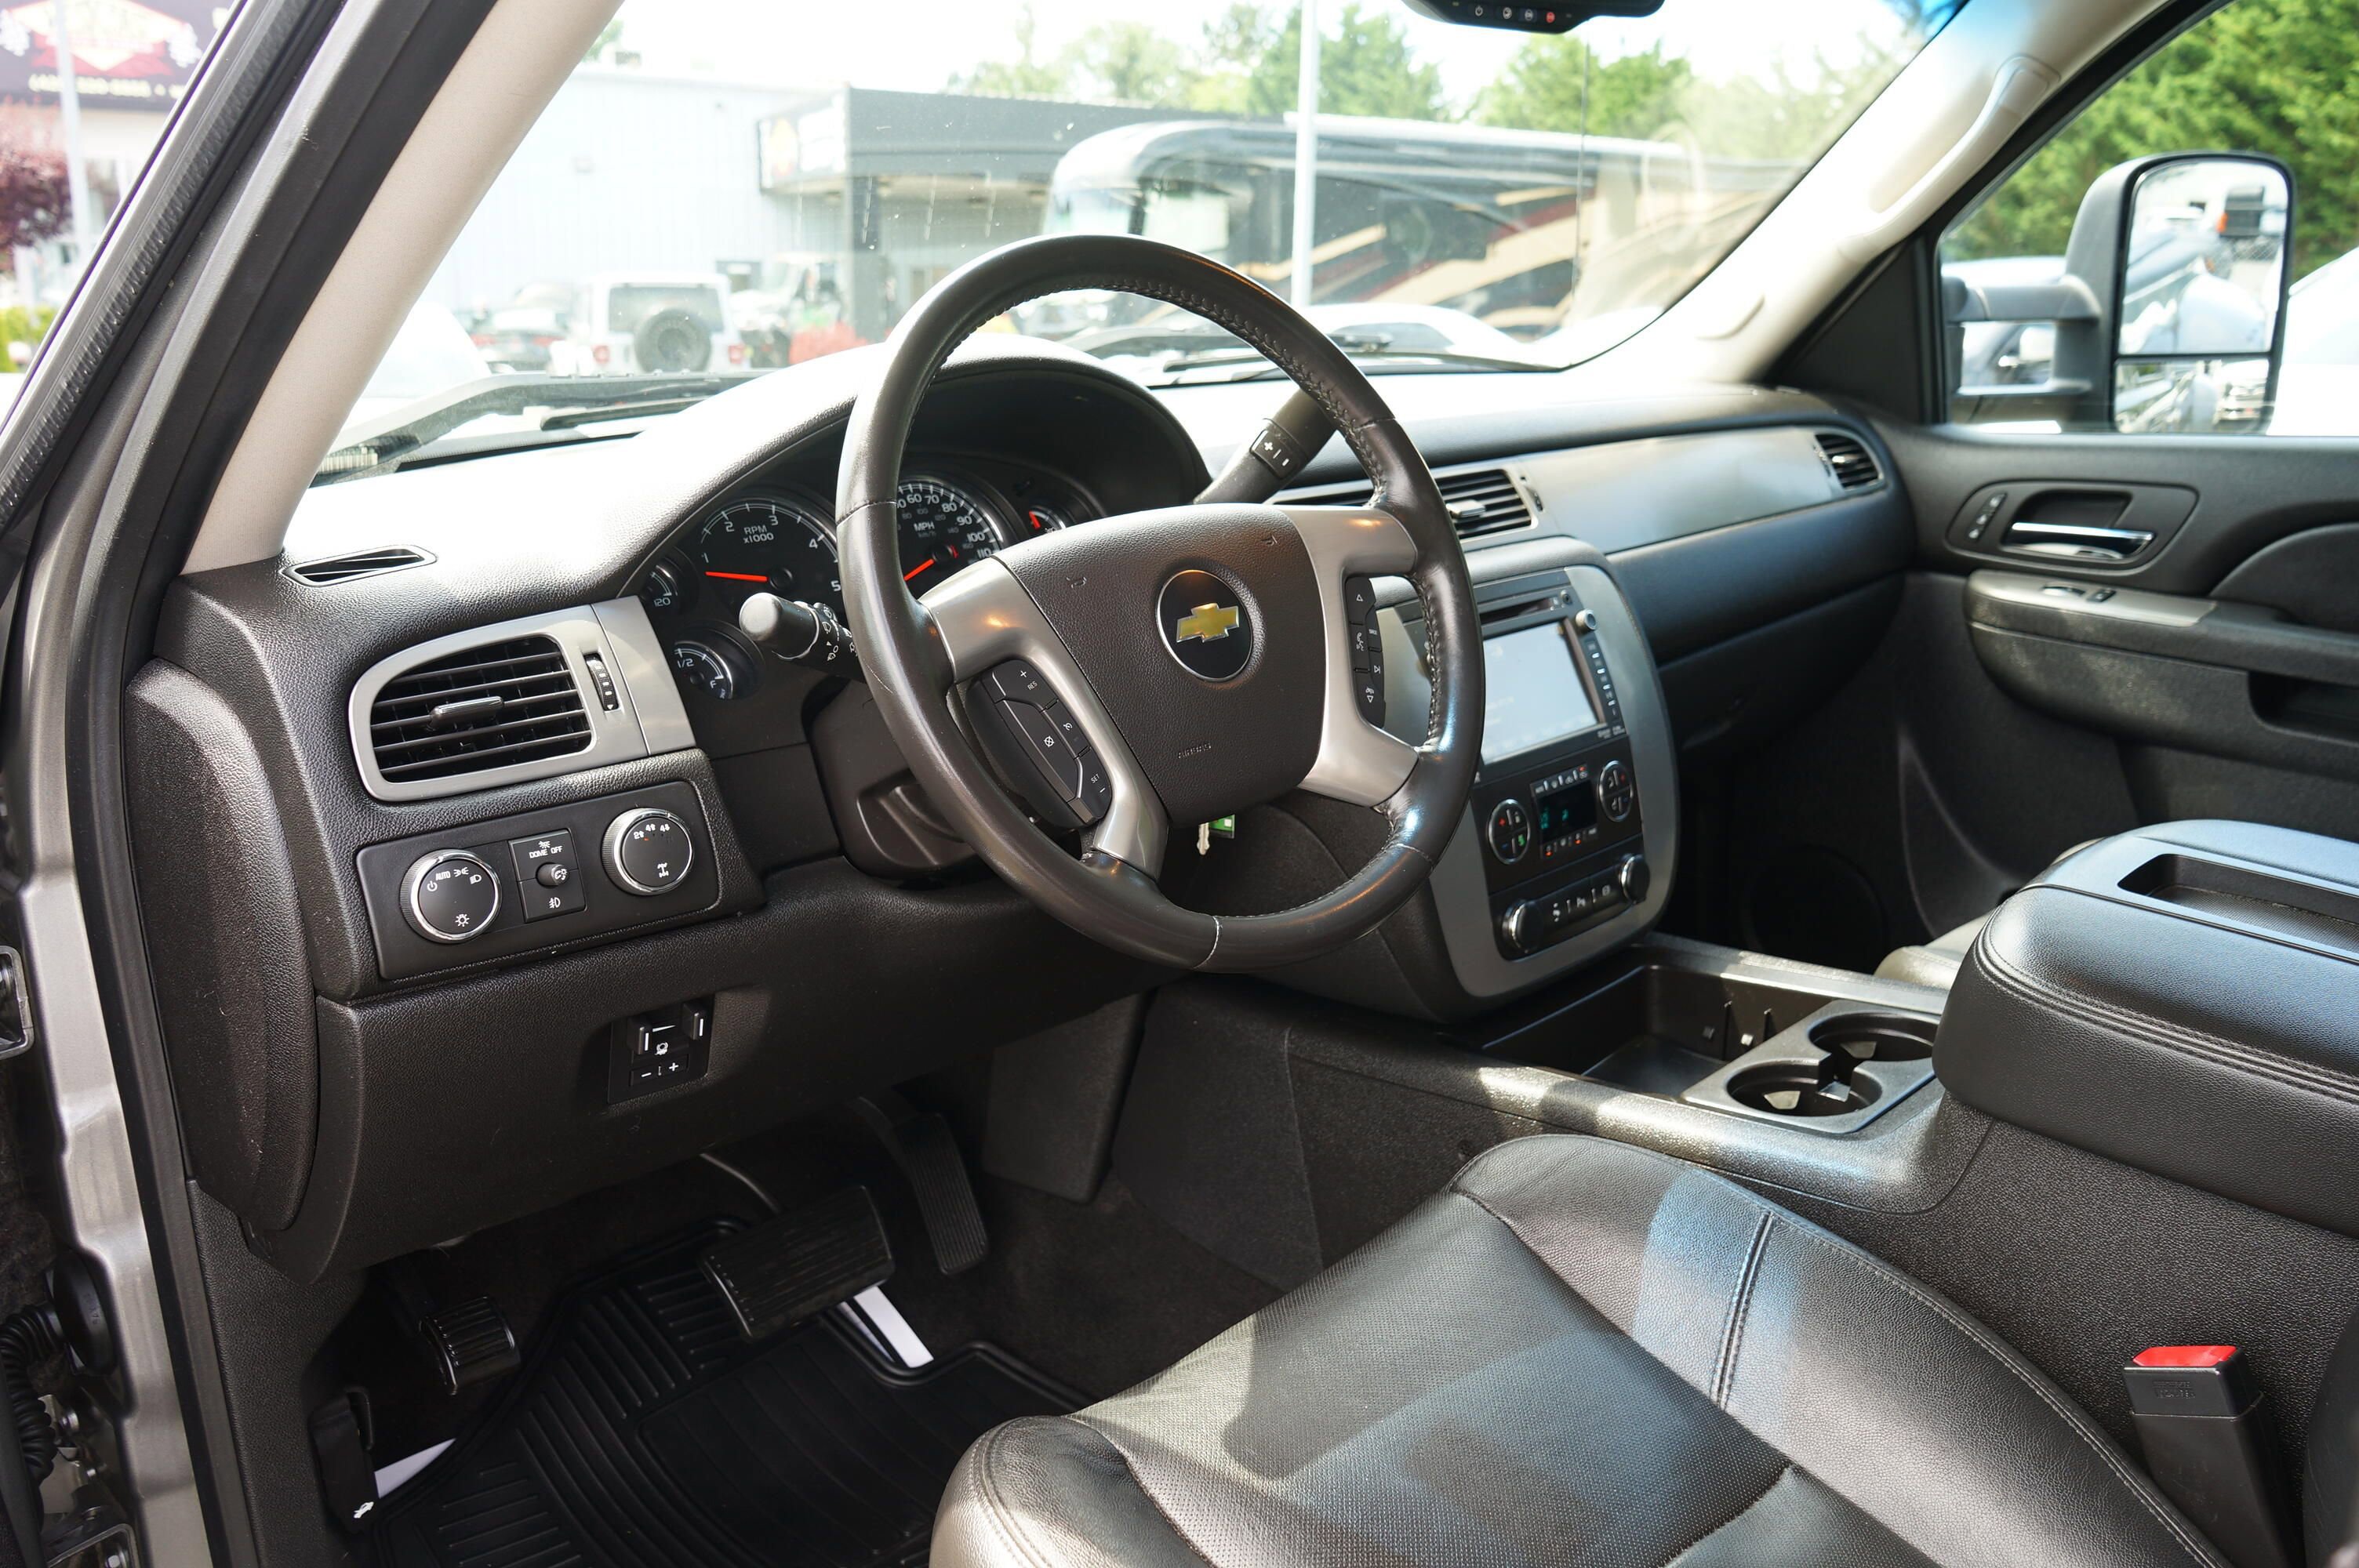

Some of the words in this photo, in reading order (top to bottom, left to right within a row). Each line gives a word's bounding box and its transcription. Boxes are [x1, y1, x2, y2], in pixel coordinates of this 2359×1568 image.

[907, 493, 922, 503] 60
[924, 494, 940, 504] 70
[941, 502, 957, 513] 80
[769, 515, 779, 526] 3
[957, 515, 972, 525] 90
[724, 521, 735, 532] 2
[743, 524, 768, 535] RPM
[914, 521, 935, 532] MPH
[743, 532, 774, 544] x1000
[967, 532, 985, 542] 100
[809, 539, 818, 549] 4
[976, 547, 992, 558] 110
[701, 553, 709, 563] 1
[831, 580, 841, 592] 5
[654, 597, 671, 607] 120
[678, 659, 694, 668] 1/2
[710, 680, 717, 688] F
[1027, 681, 1038, 691] RES
[1091, 773, 1100, 783] SET
[529, 849, 547, 858] DOME
[435, 870, 451, 881] AUTO
